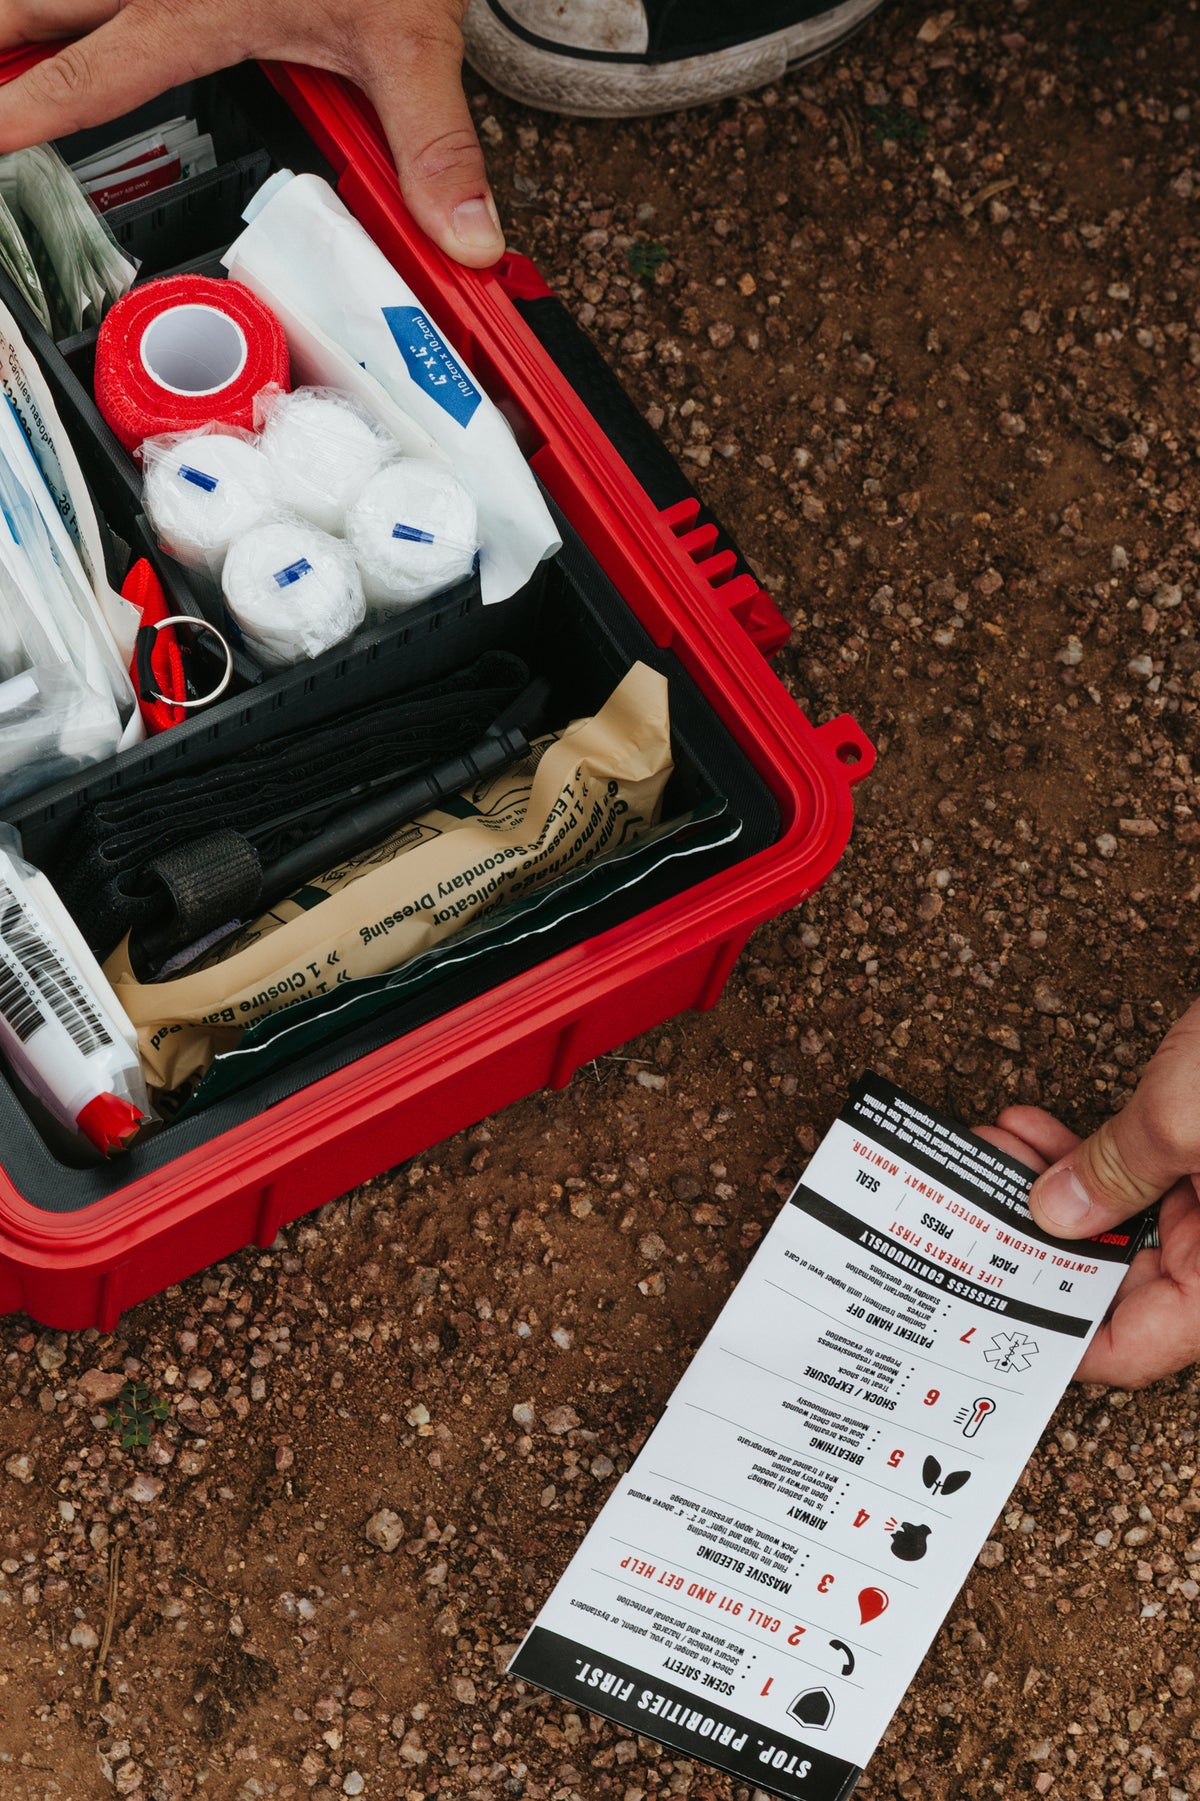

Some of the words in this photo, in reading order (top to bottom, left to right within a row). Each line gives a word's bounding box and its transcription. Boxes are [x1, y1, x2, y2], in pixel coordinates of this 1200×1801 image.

[411, 316, 442, 352] 10.2cm)
[424, 356, 437, 369] x
[445, 360, 474, 397] (10.2cm
[58, 493, 71, 515] 28
[562, 783, 576, 799] 1
[574, 800, 585, 815] 1
[509, 800, 604, 894] Hemorrhage
[521, 815, 578, 870] Pressure
[437, 845, 529, 899] Secondary
[432, 868, 518, 925] Applicator
[358, 894, 438, 946] Dressing
[305, 961, 323, 980] 1
[240, 972, 307, 1012] Closure
[200, 1005, 237, 1026] Bar
[863, 1093, 887, 1113] within
[859, 1106, 874, 1119] not
[886, 1108, 902, 1123] Use
[894, 1097, 935, 1128] experience.
[880, 1119, 897, 1133] and
[902, 1117, 932, 1142] training.
[933, 1123, 950, 1138] and
[895, 1128, 913, 1143] only
[948, 1132, 978, 1157] training
[912, 1139, 948, 1165] purposes
[930, 1136, 962, 1160] medical
[853, 1139, 899, 1176] MONITOR.
[977, 1151, 997, 1167] your
[945, 1160, 995, 1197] informational
[959, 1155, 1007, 1188] professional
[1003, 1167, 1027, 1186] scope
[856, 1169, 880, 1193] SEAL
[904, 1172, 944, 1204] AIRWAY.
[1004, 1183, 1018, 1196] for
[993, 1191, 1007, 1204] for
[945, 1200, 990, 1233] PROTECT
[888, 1222, 922, 1247] FIRST
[920, 1213, 954, 1240] PRESS
[996, 1228, 1047, 1260] BLEEDING.
[784, 1250, 800, 1262] care
[859, 1230, 945, 1284] CONTINUOUSLY
[924, 1242, 974, 1275] THREATS
[989, 1254, 1019, 1274] PACK
[1051, 1245, 1098, 1274] CONTROL
[807, 1264, 825, 1278] level
[845, 1262, 883, 1288] information
[869, 1264, 902, 1286] questions
[977, 1270, 1003, 1288] LIFE
[825, 1274, 847, 1290] higher
[1059, 1280, 1073, 1293] TQ
[846, 1286, 863, 1298] until
[883, 1284, 917, 1305] important
[913, 1288, 941, 1305] Standby
[947, 1278, 1008, 1311] REASSESS
[846, 1303, 866, 1319] OFF
[862, 1295, 896, 1317] treatment
[906, 1306, 931, 1321] arrives
[917, 1300, 936, 1314] Relay
[865, 1313, 894, 1332] HAND
[896, 1312, 927, 1330] Continue
[825, 1330, 863, 1351] evacuation
[893, 1326, 934, 1349] PATIENT
[959, 1327, 976, 1344] 7
[817, 1337, 871, 1364] responsiveness
[872, 1361, 899, 1376] Monitor
[875, 1352, 902, 1368] Prepare
[838, 1367, 859, 1379] shock
[856, 1364, 876, 1376] warm
[876, 1373, 894, 1384] Keep
[803, 1366, 854, 1394] EXPOSURE
[871, 1380, 889, 1393] Treat
[862, 1390, 897, 1411] SHOCK
[923, 1389, 940, 1406] 6
[781, 1401, 809, 1417] wounds
[796, 1397, 842, 1420] continuously
[809, 1413, 830, 1425] chest
[830, 1422, 848, 1432] open
[842, 1416, 870, 1431] Monitor
[803, 1420, 837, 1439] breathing
[848, 1429, 865, 1439] Seal
[737, 1436, 778, 1458] appropriate
[838, 1434, 860, 1447] Check
[777, 1454, 792, 1463] and
[809, 1437, 864, 1466] BREATHING
[887, 1449, 904, 1468] 5
[752, 1464, 779, 1479] needed
[771, 1462, 801, 1477] position
[792, 1460, 818, 1475] trained
[747, 1473, 777, 1490] talking?
[785, 1477, 810, 1492] airway
[801, 1473, 834, 1493] Recovery
[825, 1473, 839, 1483] NPA
[627, 1489, 652, 1502] wound
[776, 1485, 803, 1501] patient
[803, 1497, 815, 1507] the
[810, 1489, 829, 1502] Open
[652, 1499, 675, 1512] above
[670, 1494, 701, 1512] bandage
[701, 1507, 734, 1525] pressure
[786, 1506, 828, 1531] AIRWAY
[853, 1508, 870, 1528] 4
[687, 1524, 718, 1543] bleeding
[727, 1530, 743, 1540] and
[733, 1520, 754, 1533] apply
[755, 1529, 780, 1545] wound,
[718, 1537, 760, 1560] threatening
[763, 1545, 772, 1555] TQ
[773, 1549, 794, 1564] Apply
[781, 1541, 799, 1555] Pack
[620, 1556, 656, 1579] HELP
[696, 1545, 745, 1573] BLEEDING
[760, 1555, 772, 1566] life
[772, 1561, 788, 1574] Find
[657, 1571, 684, 1590] GET
[745, 1566, 792, 1594] MASSIVE
[817, 1574, 835, 1593] 3
[687, 1583, 717, 1604] AND
[570, 1599, 611, 1621] bystanders
[616, 1595, 654, 1615] protection
[718, 1596, 743, 1616] 911
[621, 1620, 648, 1636] patient,
[653, 1611, 687, 1629] personal
[748, 1608, 781, 1632] CALL
[650, 1632, 665, 1644] you,
[652, 1622, 681, 1640] hazards
[686, 1625, 701, 1635] and
[701, 1631, 726, 1646] gloves
[787, 1625, 806, 1646] 2
[673, 1644, 699, 1659] danger
[687, 1637, 713, 1653] vehicle
[726, 1643, 745, 1656] Wear
[714, 1649, 740, 1666] Secure
[662, 1657, 701, 1681] SAFETY
[711, 1660, 734, 1676] Check
[575, 1659, 635, 1702] FIRST.
[701, 1673, 735, 1696] SCENE
[760, 1677, 774, 1696] 1
[637, 1690, 749, 1752] PRIORITIES
[757, 1740, 812, 1778] STOP.
